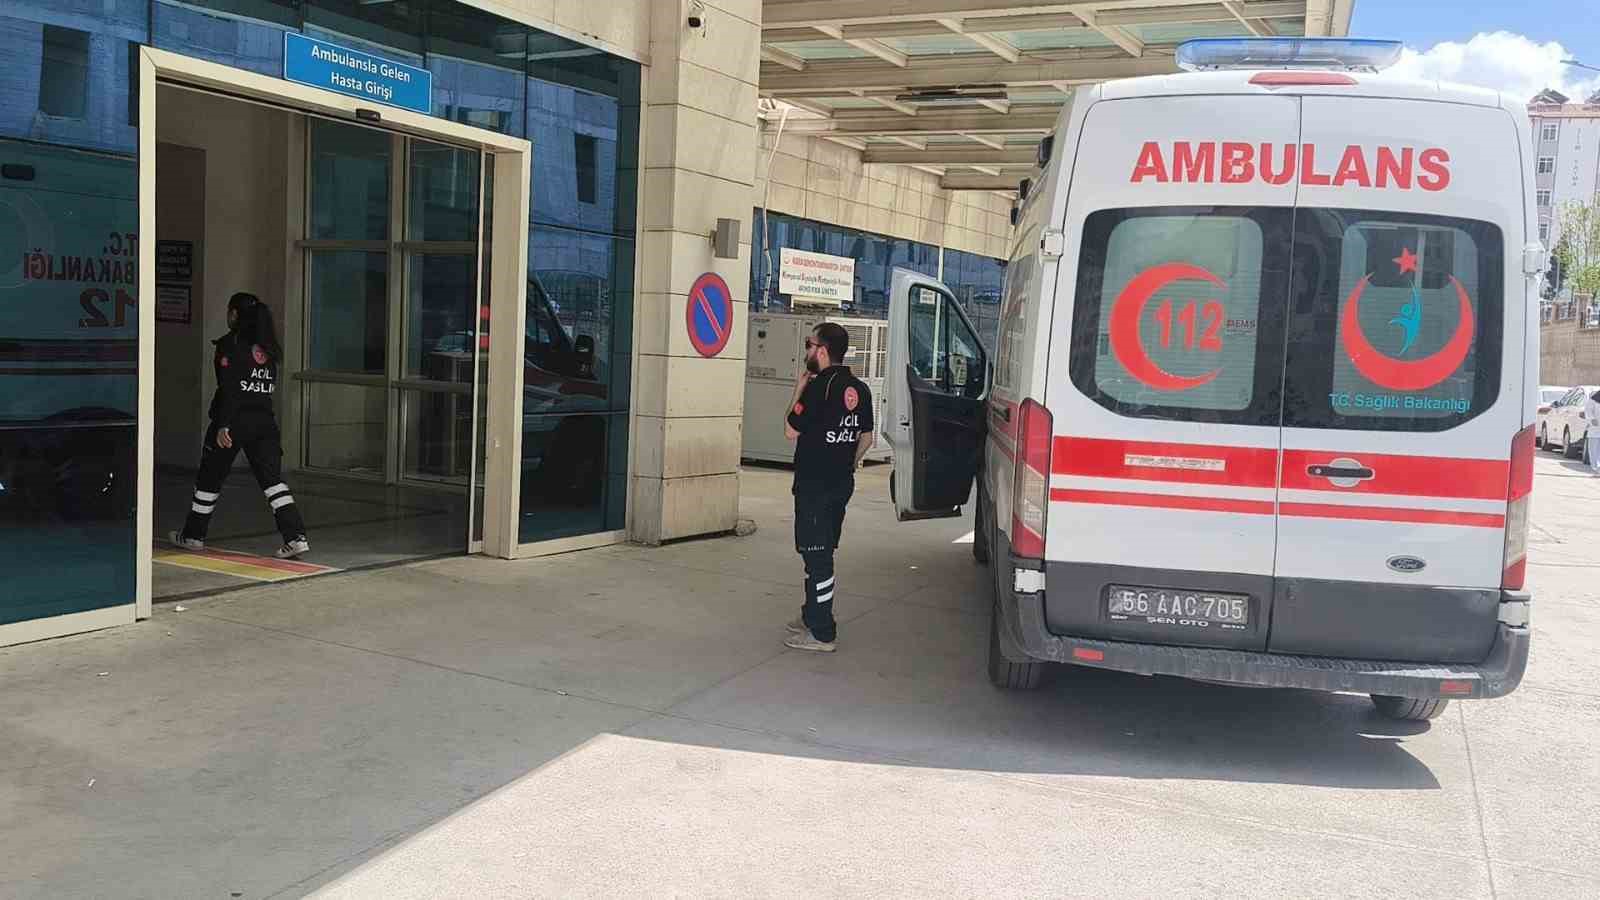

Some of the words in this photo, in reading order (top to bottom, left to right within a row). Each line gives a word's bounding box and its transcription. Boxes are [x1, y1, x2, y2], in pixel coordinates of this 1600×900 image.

[311, 45, 378, 73] Ambulansla
[380, 64, 411, 82] Gelen
[331, 72, 362, 90] Hasta
[365, 81, 393, 100] Girişi
[1130, 141, 1450, 191] AMBULANS
[1154, 299, 1224, 352] 112
[1122, 591, 1149, 612] 56
[1157, 594, 1197, 616] AAC
[1202, 597, 1243, 620] 705
[1179, 619, 1209, 627] OTO
